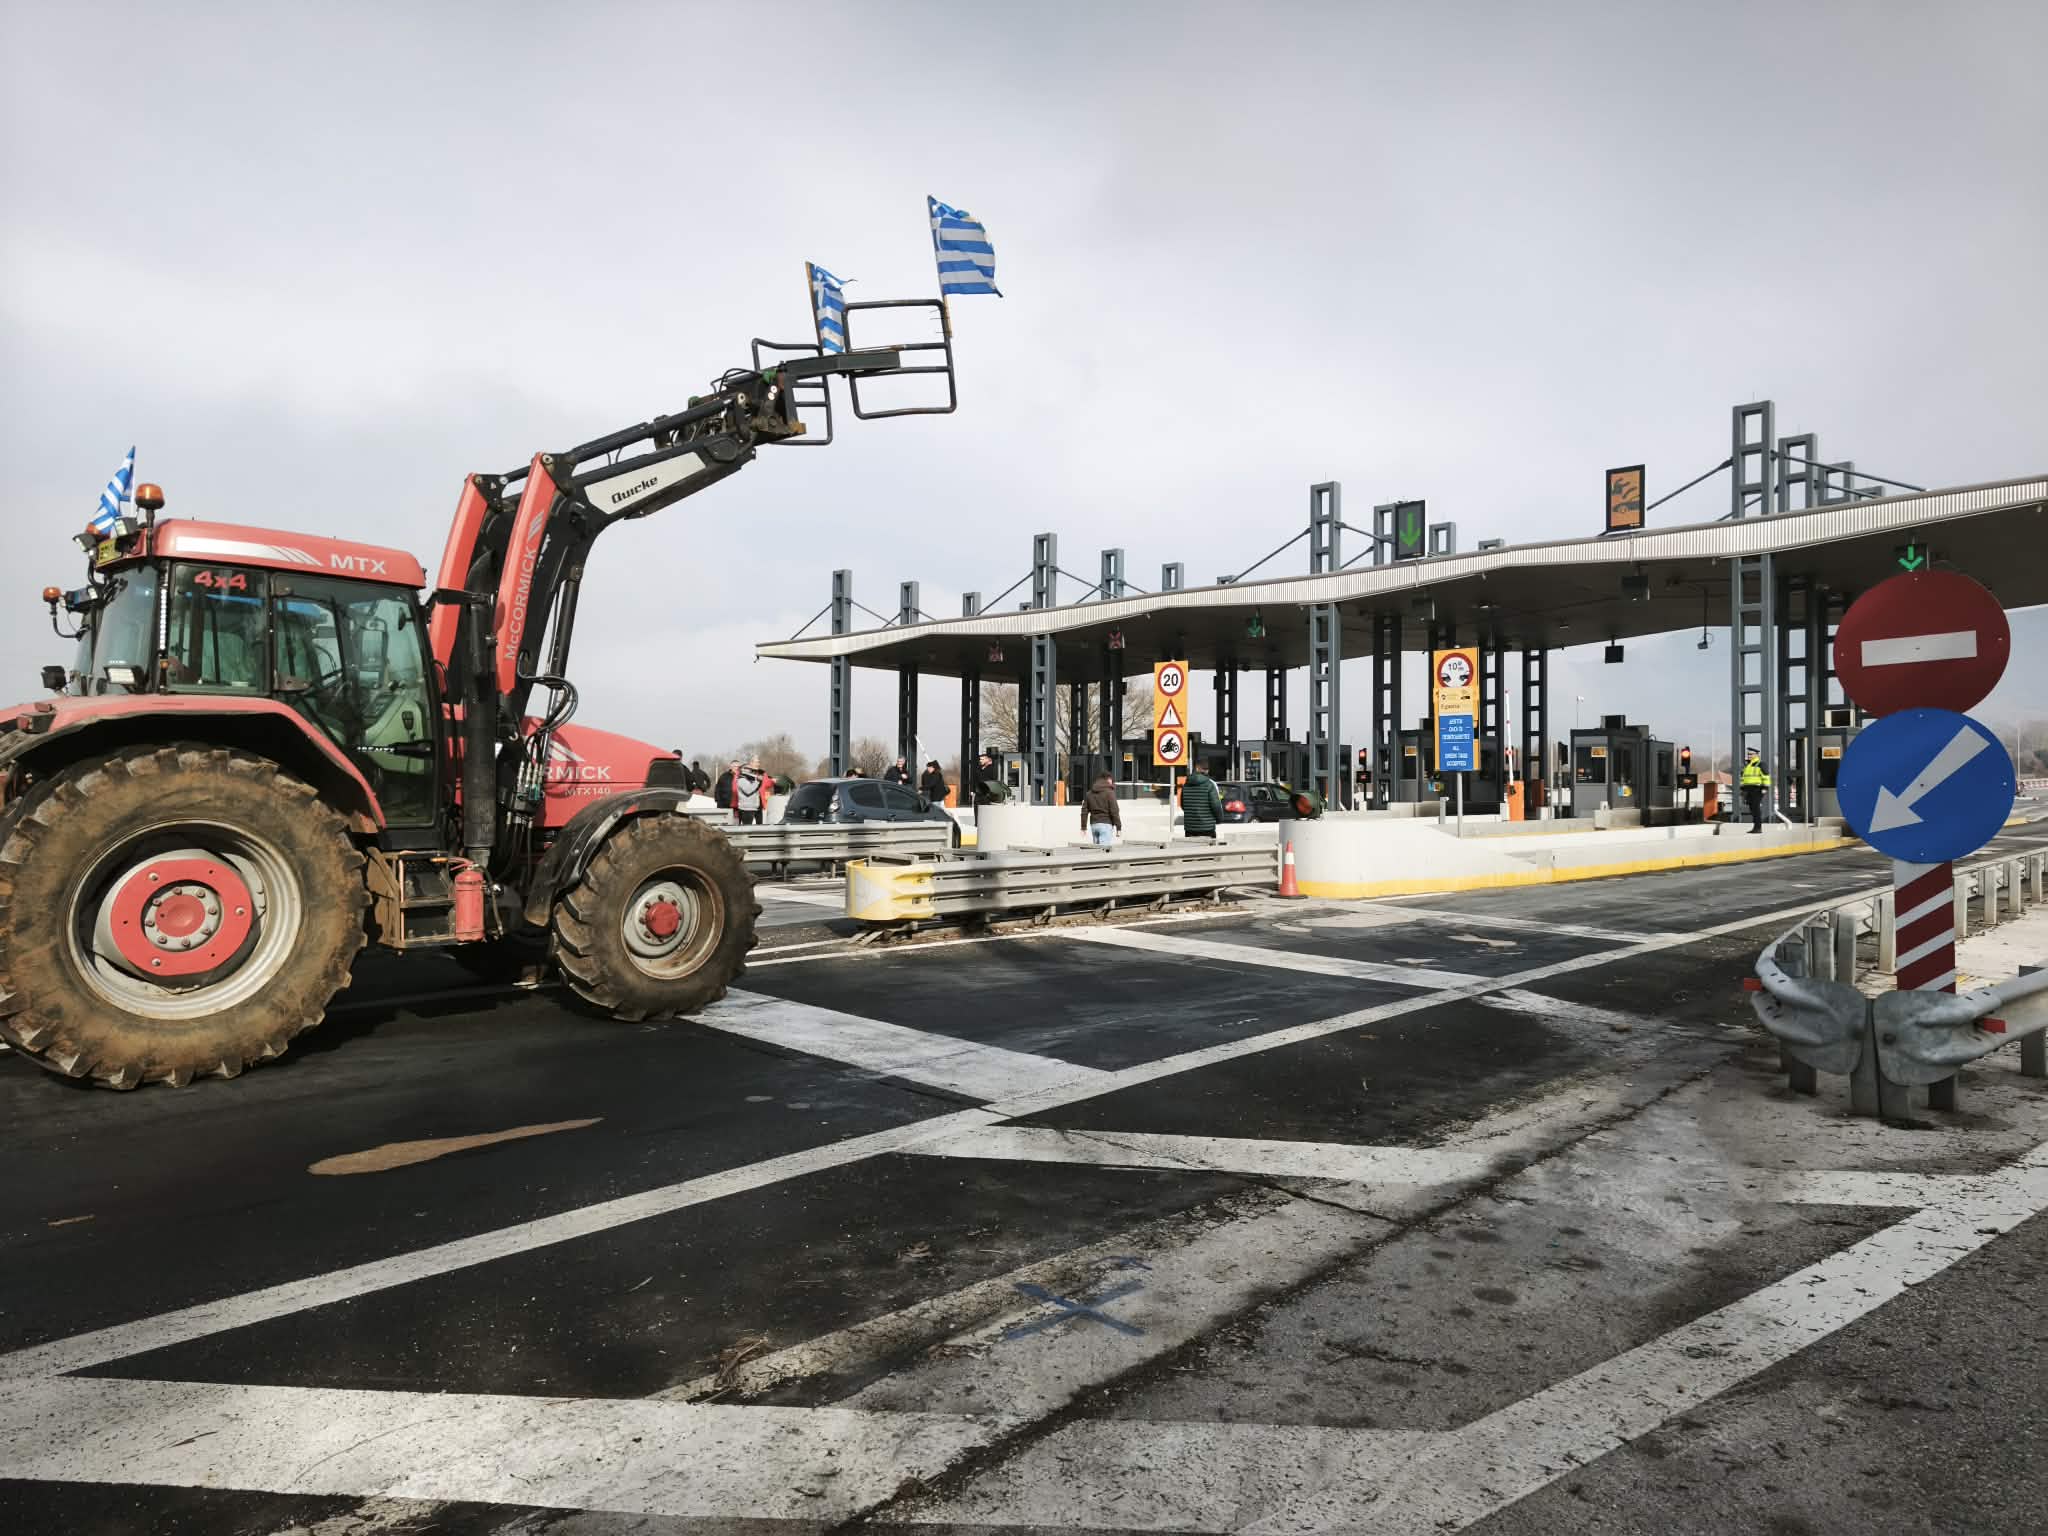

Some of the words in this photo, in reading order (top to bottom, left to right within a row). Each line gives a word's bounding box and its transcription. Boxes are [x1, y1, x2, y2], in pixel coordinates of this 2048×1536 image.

[611, 476, 658, 504] Quicke
[331, 554, 387, 574] MTX
[194, 570, 247, 590] 4x4
[504, 545, 538, 660] McCORMICK
[1163, 674, 1179, 687] 20
[544, 766, 612, 780] RMICK
